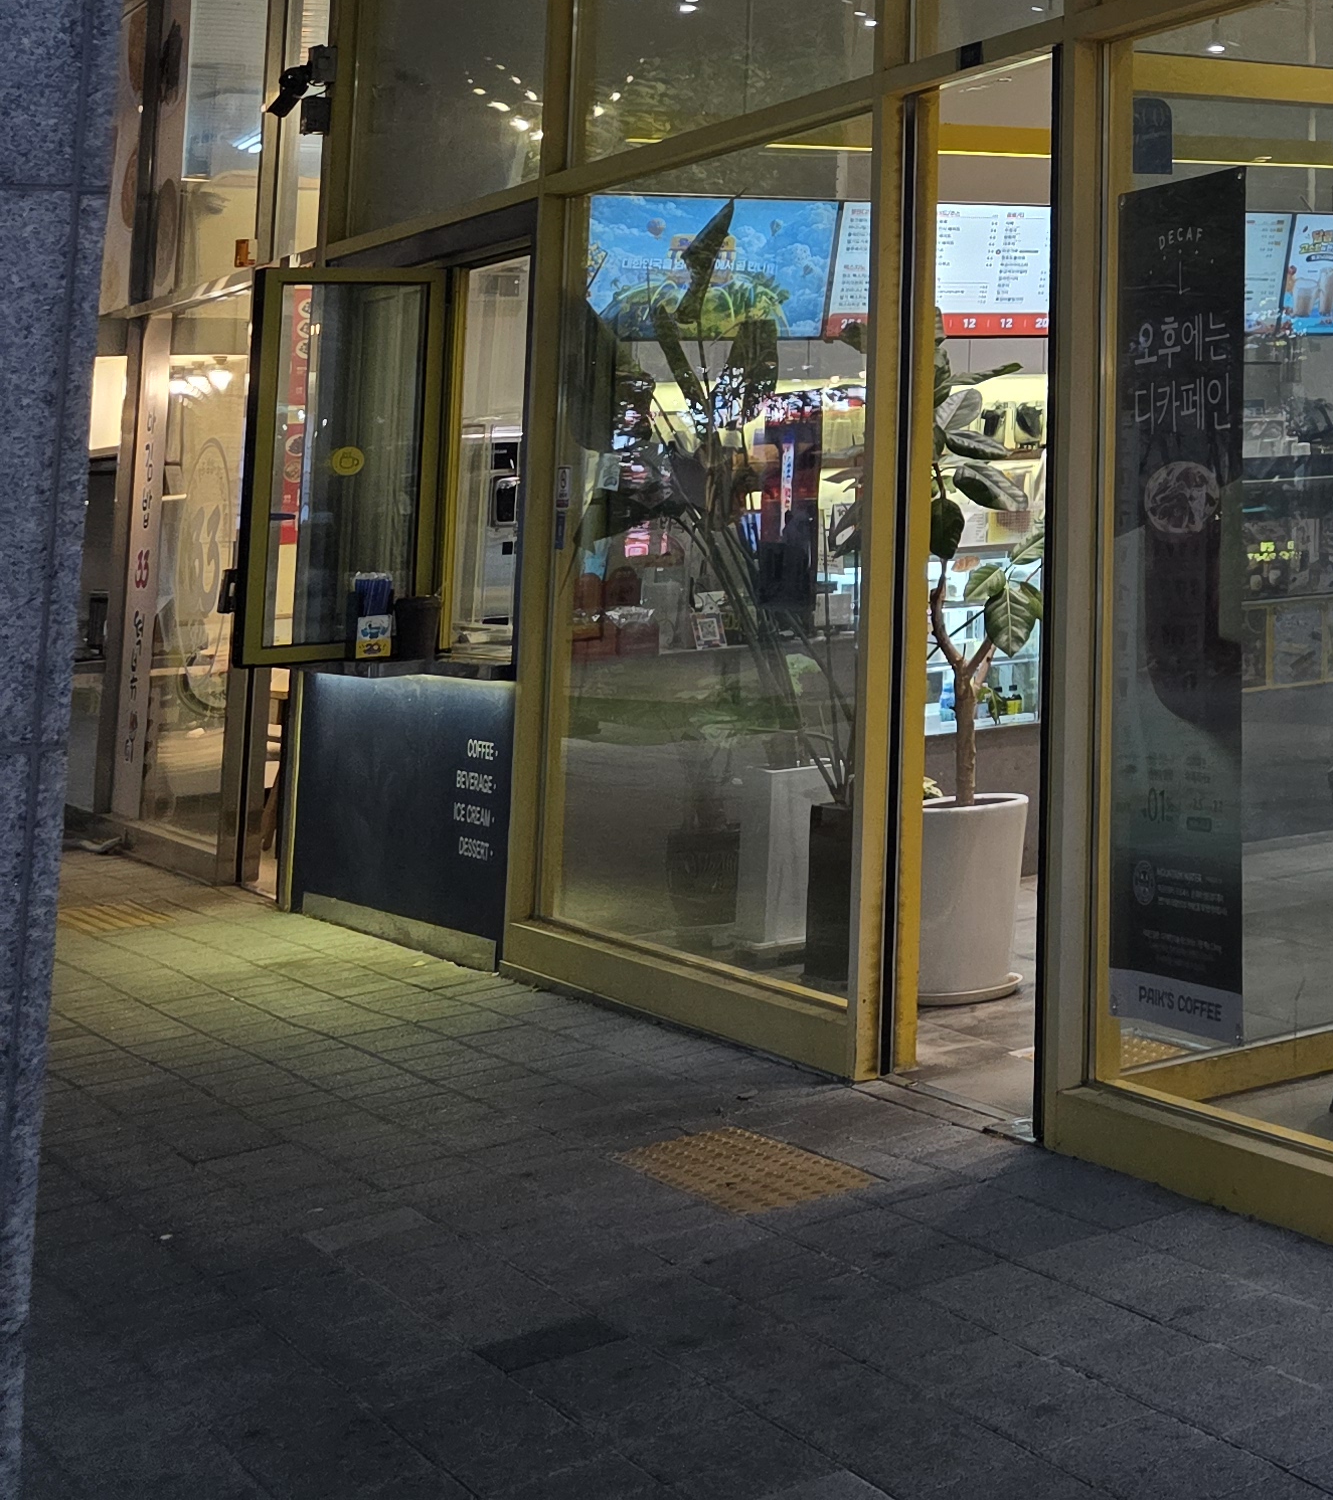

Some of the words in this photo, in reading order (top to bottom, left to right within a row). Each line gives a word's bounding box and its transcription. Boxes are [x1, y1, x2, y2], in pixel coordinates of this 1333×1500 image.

[1159, 227, 1204, 250] DECAF
[963, 317, 977, 329] 12
[1000, 317, 1013, 329] 12
[1134, 312, 1232, 370] 오후에는
[1134, 372, 1232, 436] 디카페인
[467, 738, 494, 761] COFFEE
[456, 769, 492, 794] BEVERAGE
[453, 801, 466, 822] ICE
[466, 803, 491, 828] CREAM
[458, 836, 489, 862] DESSERT
[1138, 985, 1175, 1011] PAIK'S
[1178, 994, 1223, 1022] COFFEE
